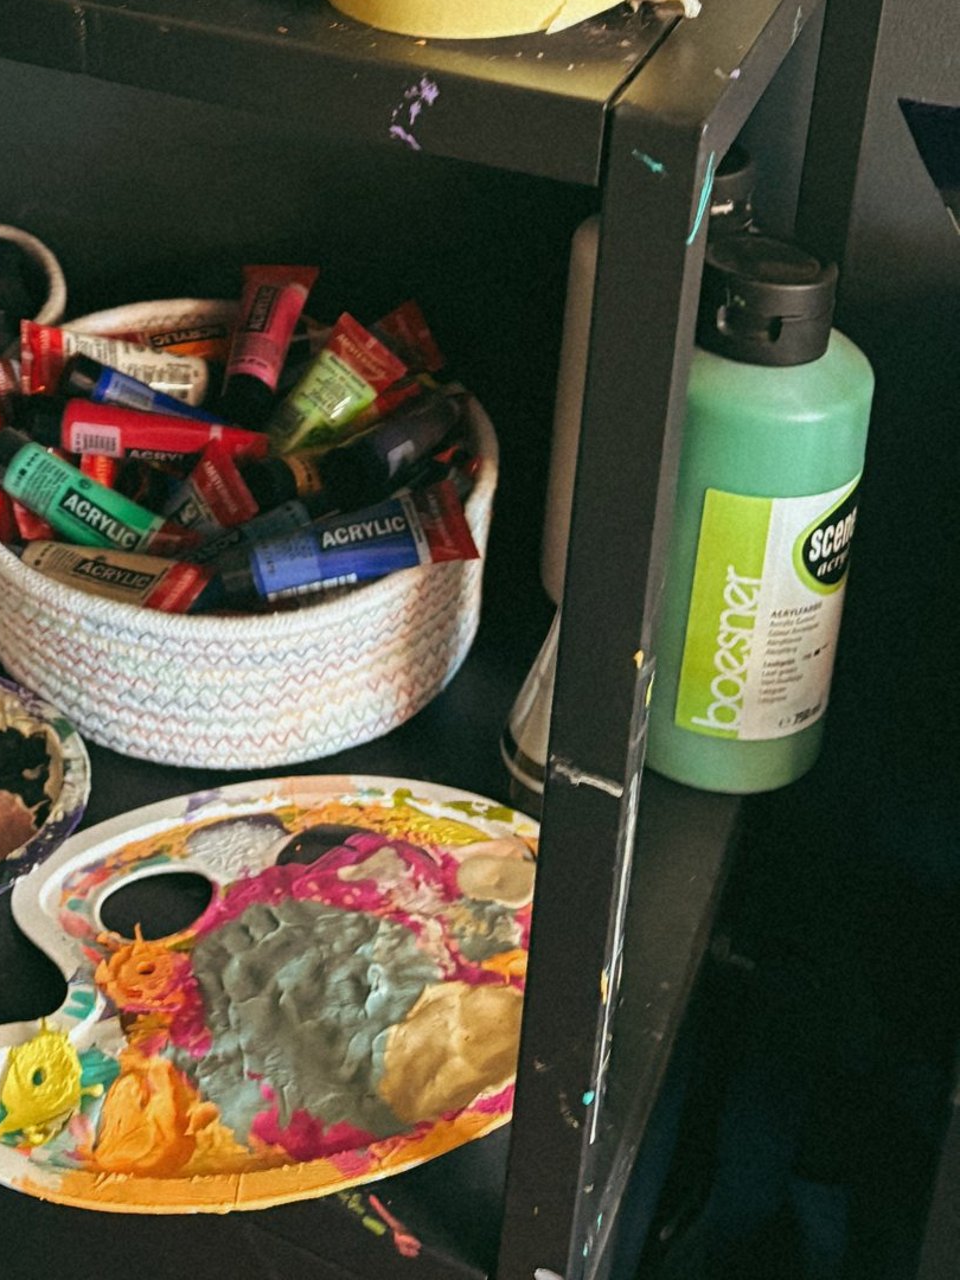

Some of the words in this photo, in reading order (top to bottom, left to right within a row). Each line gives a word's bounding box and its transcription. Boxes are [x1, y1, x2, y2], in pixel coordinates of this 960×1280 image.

[63, 493, 137, 550] ACRYLIC
[322, 516, 406, 548] ACRYLIC
[809, 506, 858, 562] scen
[78, 561, 151, 589] ACRYLIC
[691, 565, 762, 731] boesner
